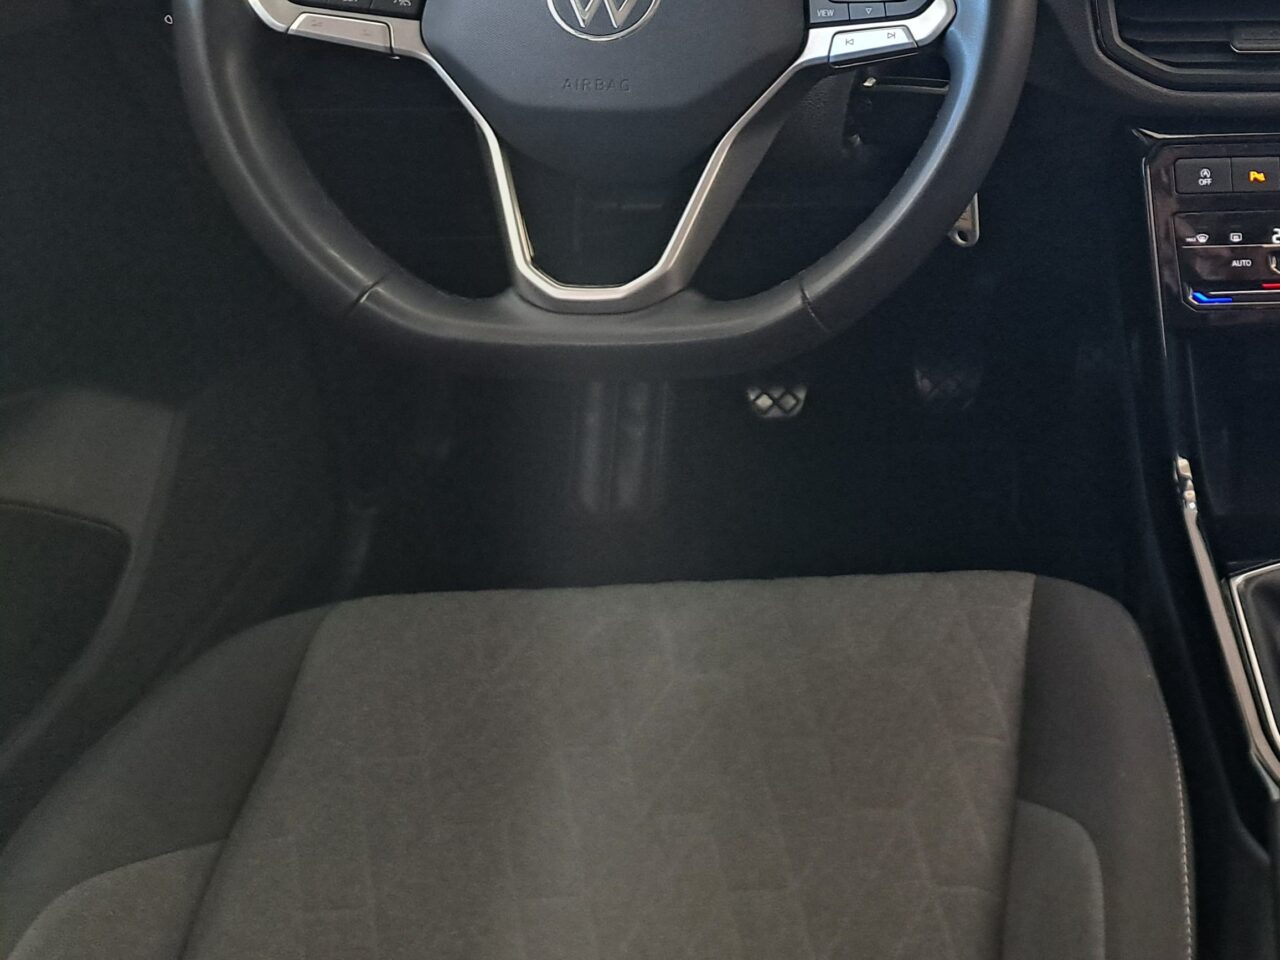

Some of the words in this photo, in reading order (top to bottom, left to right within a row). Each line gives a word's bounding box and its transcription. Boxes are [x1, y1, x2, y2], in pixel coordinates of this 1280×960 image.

[817, 9, 834, 17] VIEW
[562, 78, 630, 91] AIRBAG
[1198, 178, 1212, 186] OFF
[1231, 259, 1252, 267] AUTO
